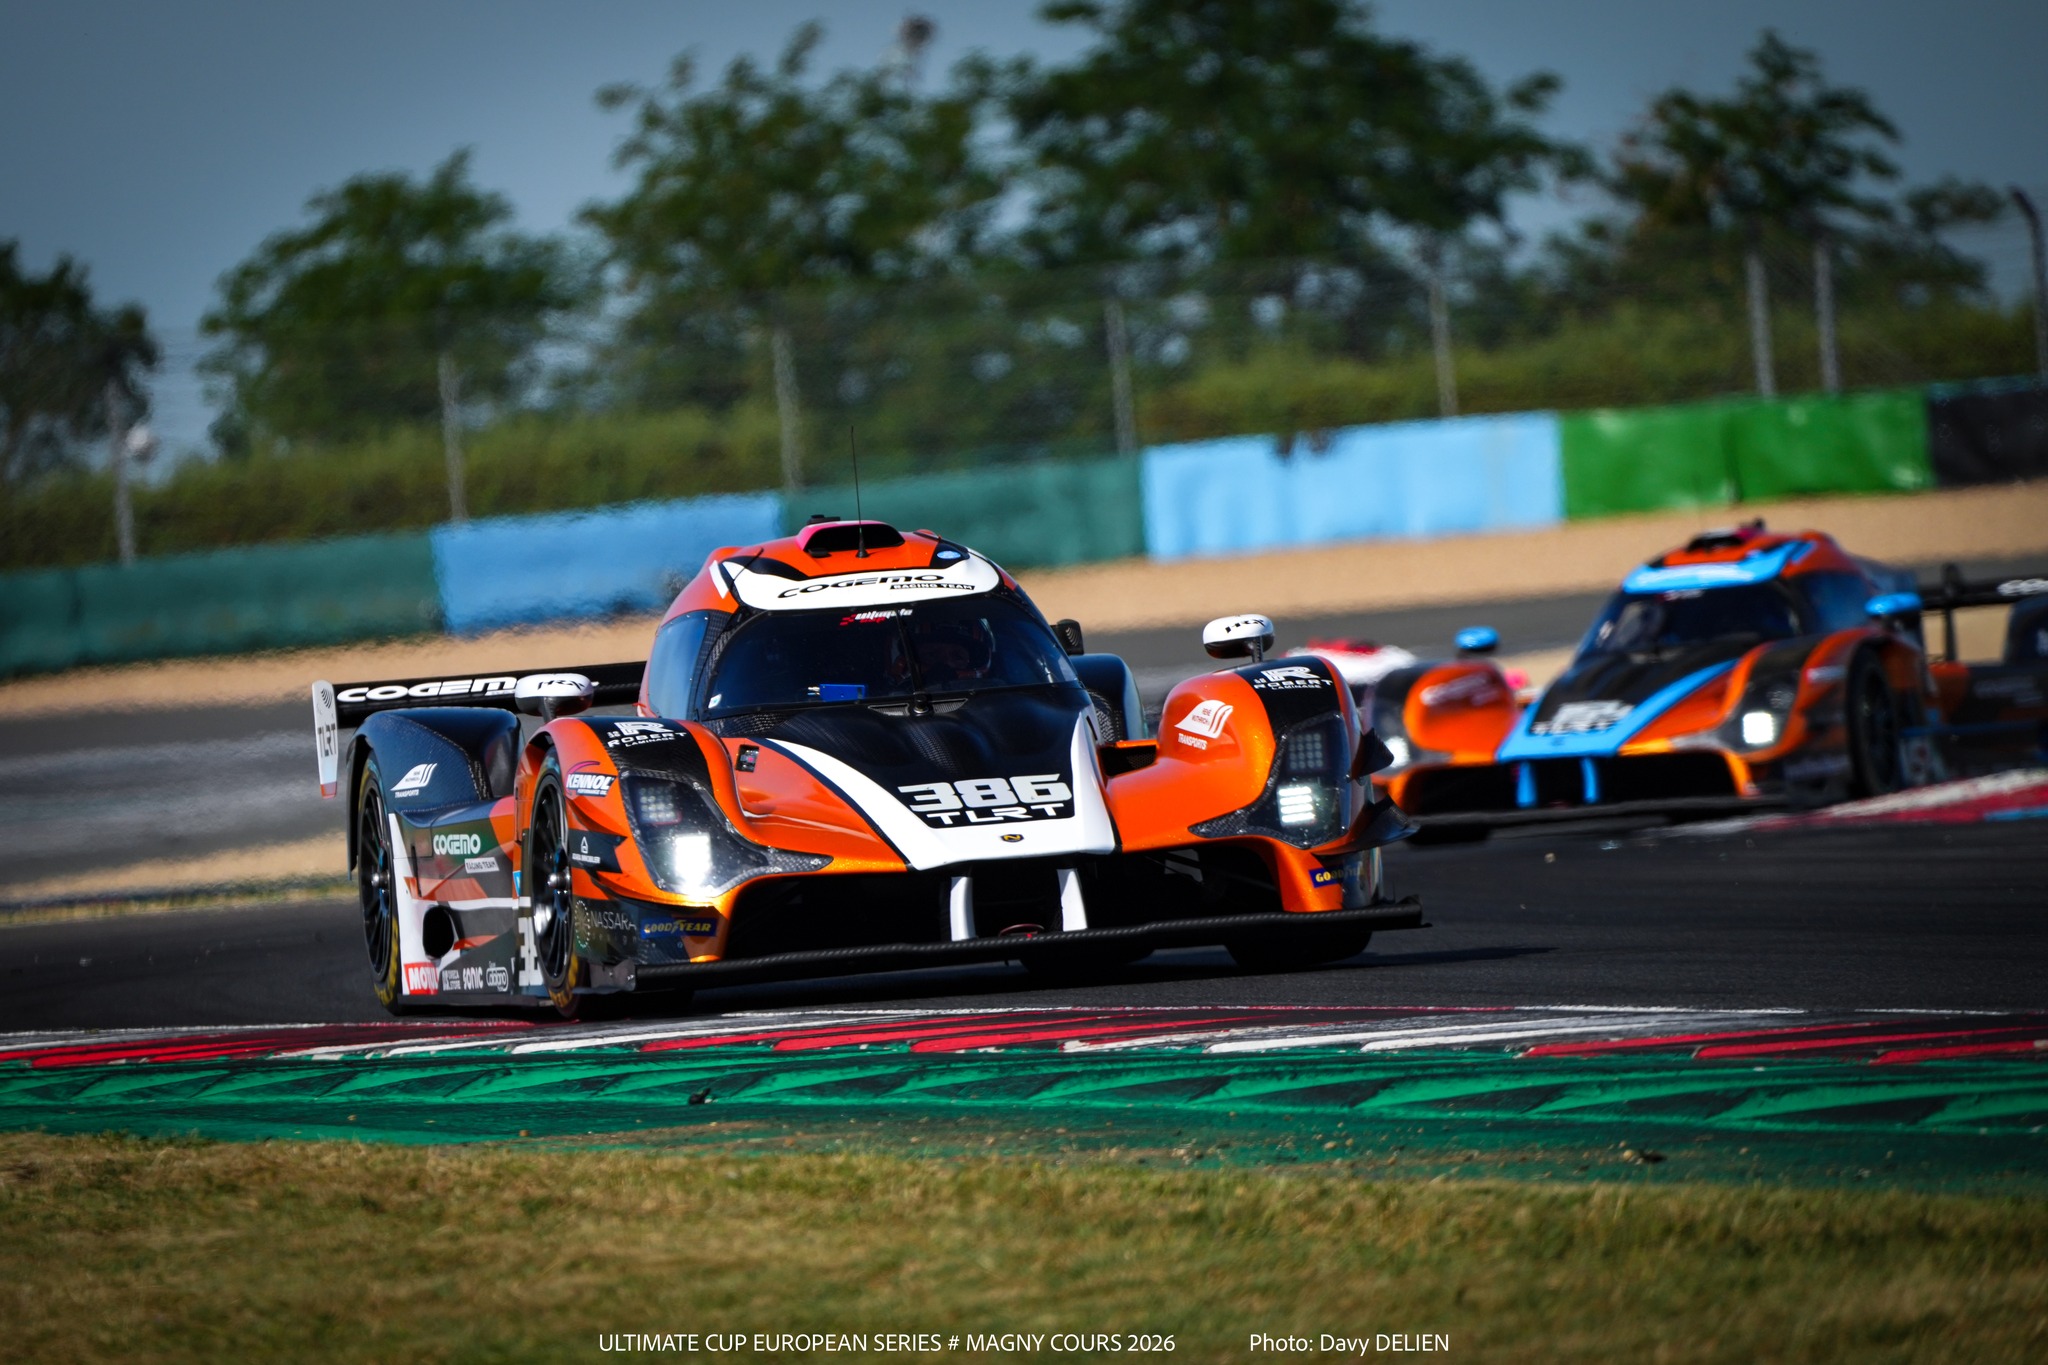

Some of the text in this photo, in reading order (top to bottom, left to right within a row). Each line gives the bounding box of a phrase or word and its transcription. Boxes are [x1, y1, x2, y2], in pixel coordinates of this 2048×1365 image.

[777, 574, 945, 599] COGEMO
[336, 676, 518, 702] COGEM
[607, 731, 688, 748] ROBERT
[625, 737, 676, 748] LAMINAGE
[1178, 732, 1208, 751] TRANSPORTS
[566, 773, 612, 791] KENNOL
[897, 773, 1073, 812] 386
[926, 802, 1065, 825] TLRT
[432, 833, 482, 856] COGEMO
[466, 860, 496, 871] RACING TEAM
[643, 918, 712, 935] GOODYEAR
[408, 966, 439, 991] MOTUL
[463, 966, 484, 991] SONIC
